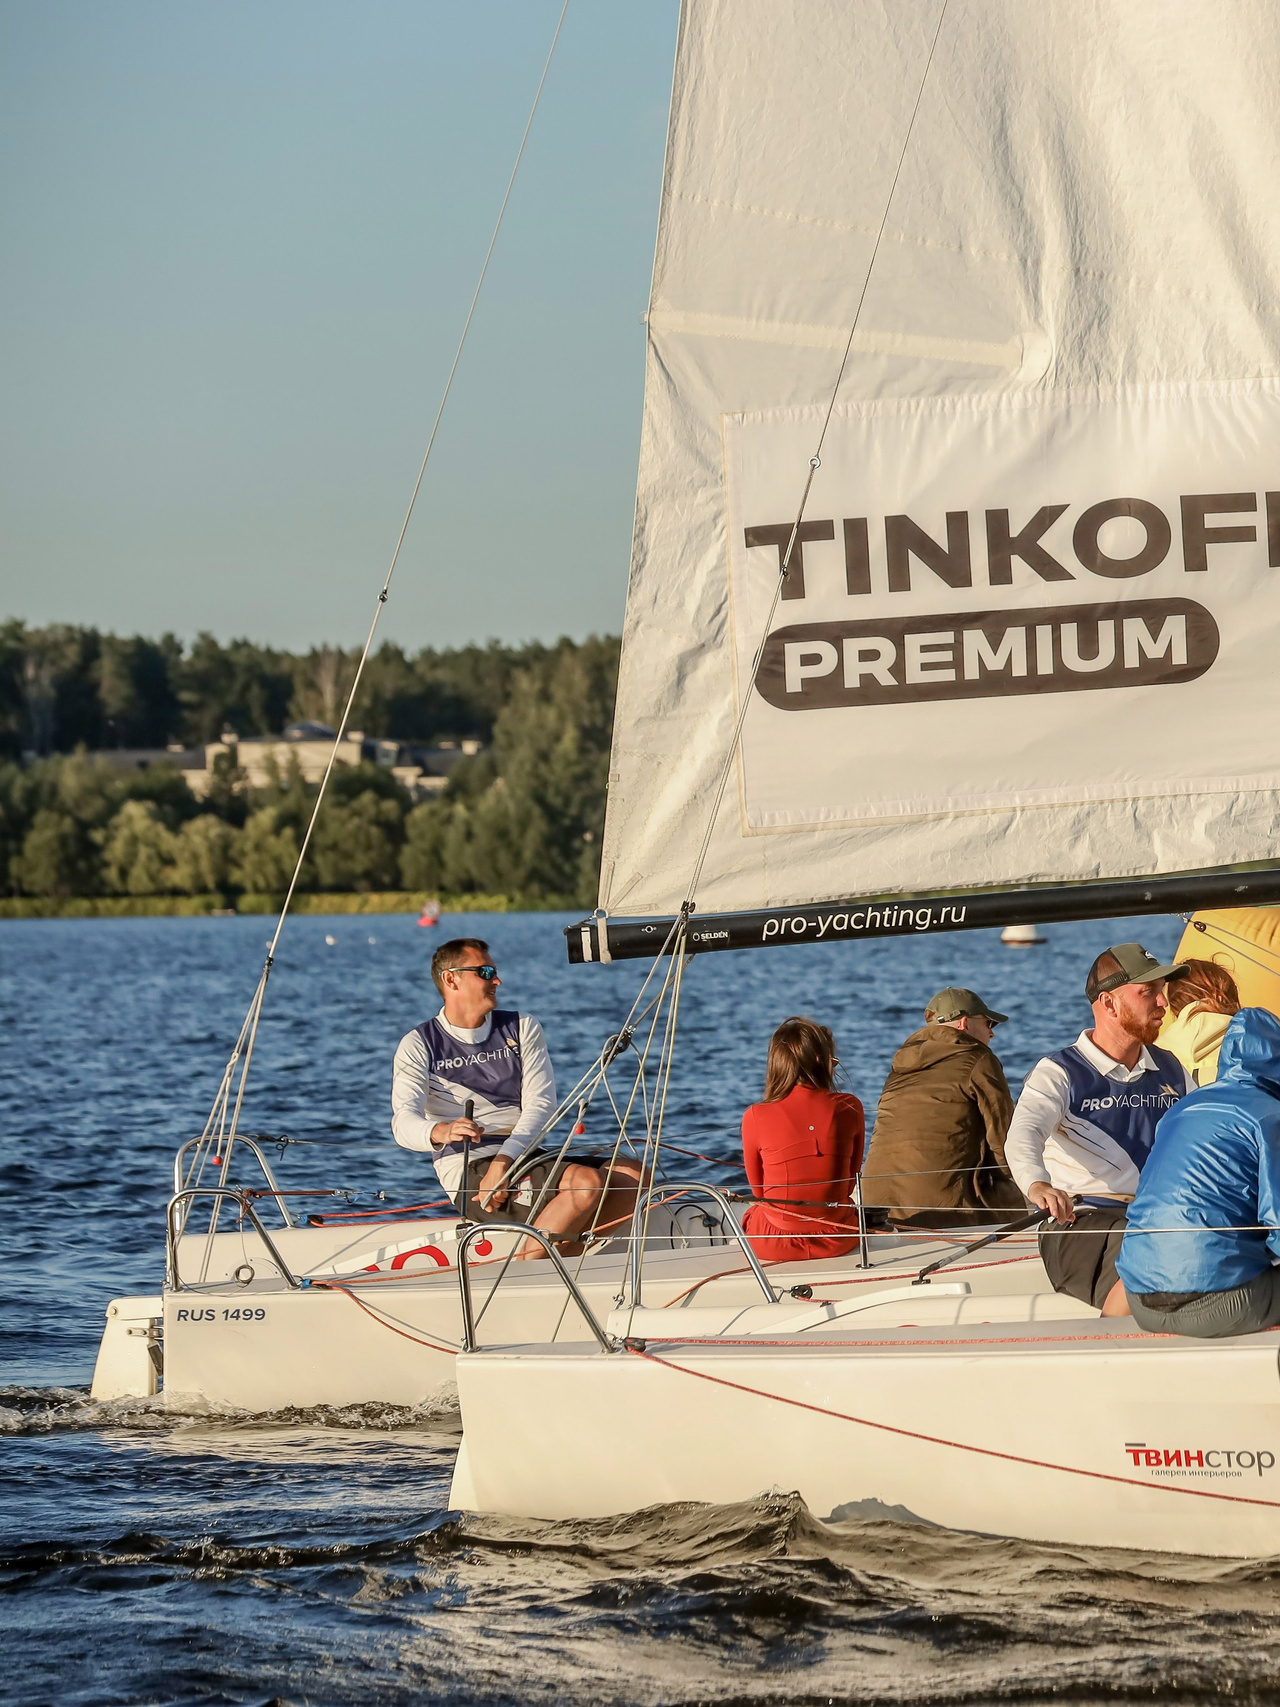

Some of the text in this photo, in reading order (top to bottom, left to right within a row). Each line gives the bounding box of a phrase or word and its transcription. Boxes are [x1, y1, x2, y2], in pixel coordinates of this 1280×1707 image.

[783, 614, 1188, 692] PREMIUM
[762, 904, 968, 940] pro-yachting.ru
[177, 1308, 266, 1322] RUS 1499
[1151, 1469, 1242, 1479] галерея интерьеров
